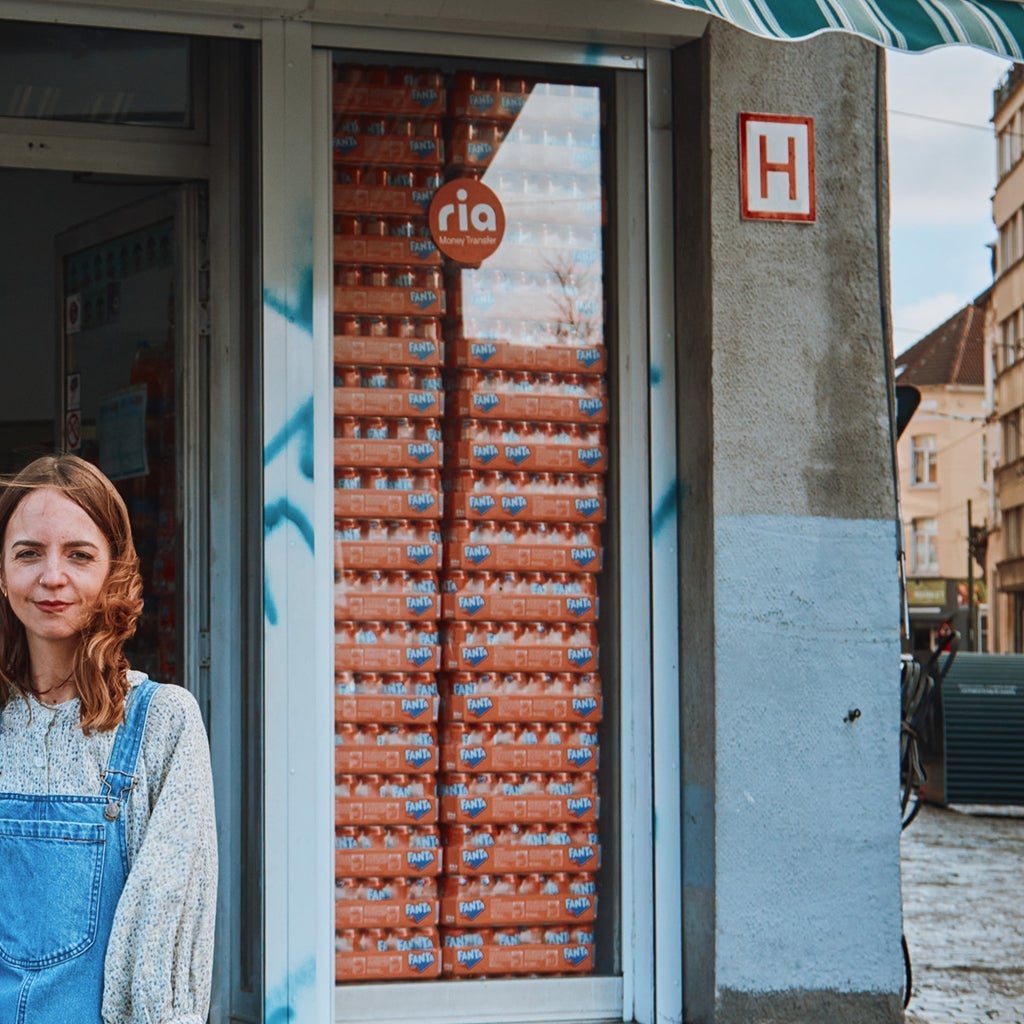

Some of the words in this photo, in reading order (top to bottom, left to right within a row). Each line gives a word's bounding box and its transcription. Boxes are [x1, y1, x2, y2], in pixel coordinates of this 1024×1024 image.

[759, 134, 796, 200] H
[438, 188, 496, 232] ria
[439, 236, 465, 246] Money
[466, 235, 497, 245] Transfer
[409, 342, 435, 353] FANTA
[471, 344, 496, 355] FANTA
[409, 394, 435, 405] FANTA
[474, 394, 499, 406] FANTA
[579, 399, 603, 410] FANTA
[408, 444, 434, 455] FANTA
[473, 445, 498, 457] FANTA
[505, 446, 530, 458] FANTA
[578, 449, 602, 460] FANTA
[408, 494, 434, 506] FANTA
[469, 496, 494, 508] FANTA
[502, 496, 527, 508] FANTA
[575, 499, 600, 510] FANTA
[407, 545, 433, 557] FANTA
[464, 545, 490, 557] FANTA
[571, 549, 596, 560] FANTA
[406, 597, 432, 608] FANTA
[459, 597, 485, 608] FANTA
[566, 598, 591, 610] FANTA
[406, 648, 432, 660] FANTA
[462, 648, 488, 659] FANTA
[568, 649, 592, 660] FANTA
[401, 698, 429, 710] FANTA
[466, 697, 493, 710] FANTA
[572, 697, 597, 709] FANTA
[405, 749, 431, 761] FANTA
[460, 748, 486, 760] FANTA
[567, 748, 592, 760] FANTA
[405, 800, 431, 812] FANTA
[461, 798, 487, 811] FANTA
[567, 799, 592, 811] FANTA
[407, 851, 434, 863] FANTA
[462, 849, 488, 861] FANTA
[569, 848, 594, 860] FANTA
[405, 902, 432, 914] FANTA
[459, 900, 485, 912] FANTA
[565, 898, 590, 910] FANTA
[408, 952, 434, 965] FANTA
[457, 949, 483, 962] FANTA
[564, 947, 589, 959] FANTA
